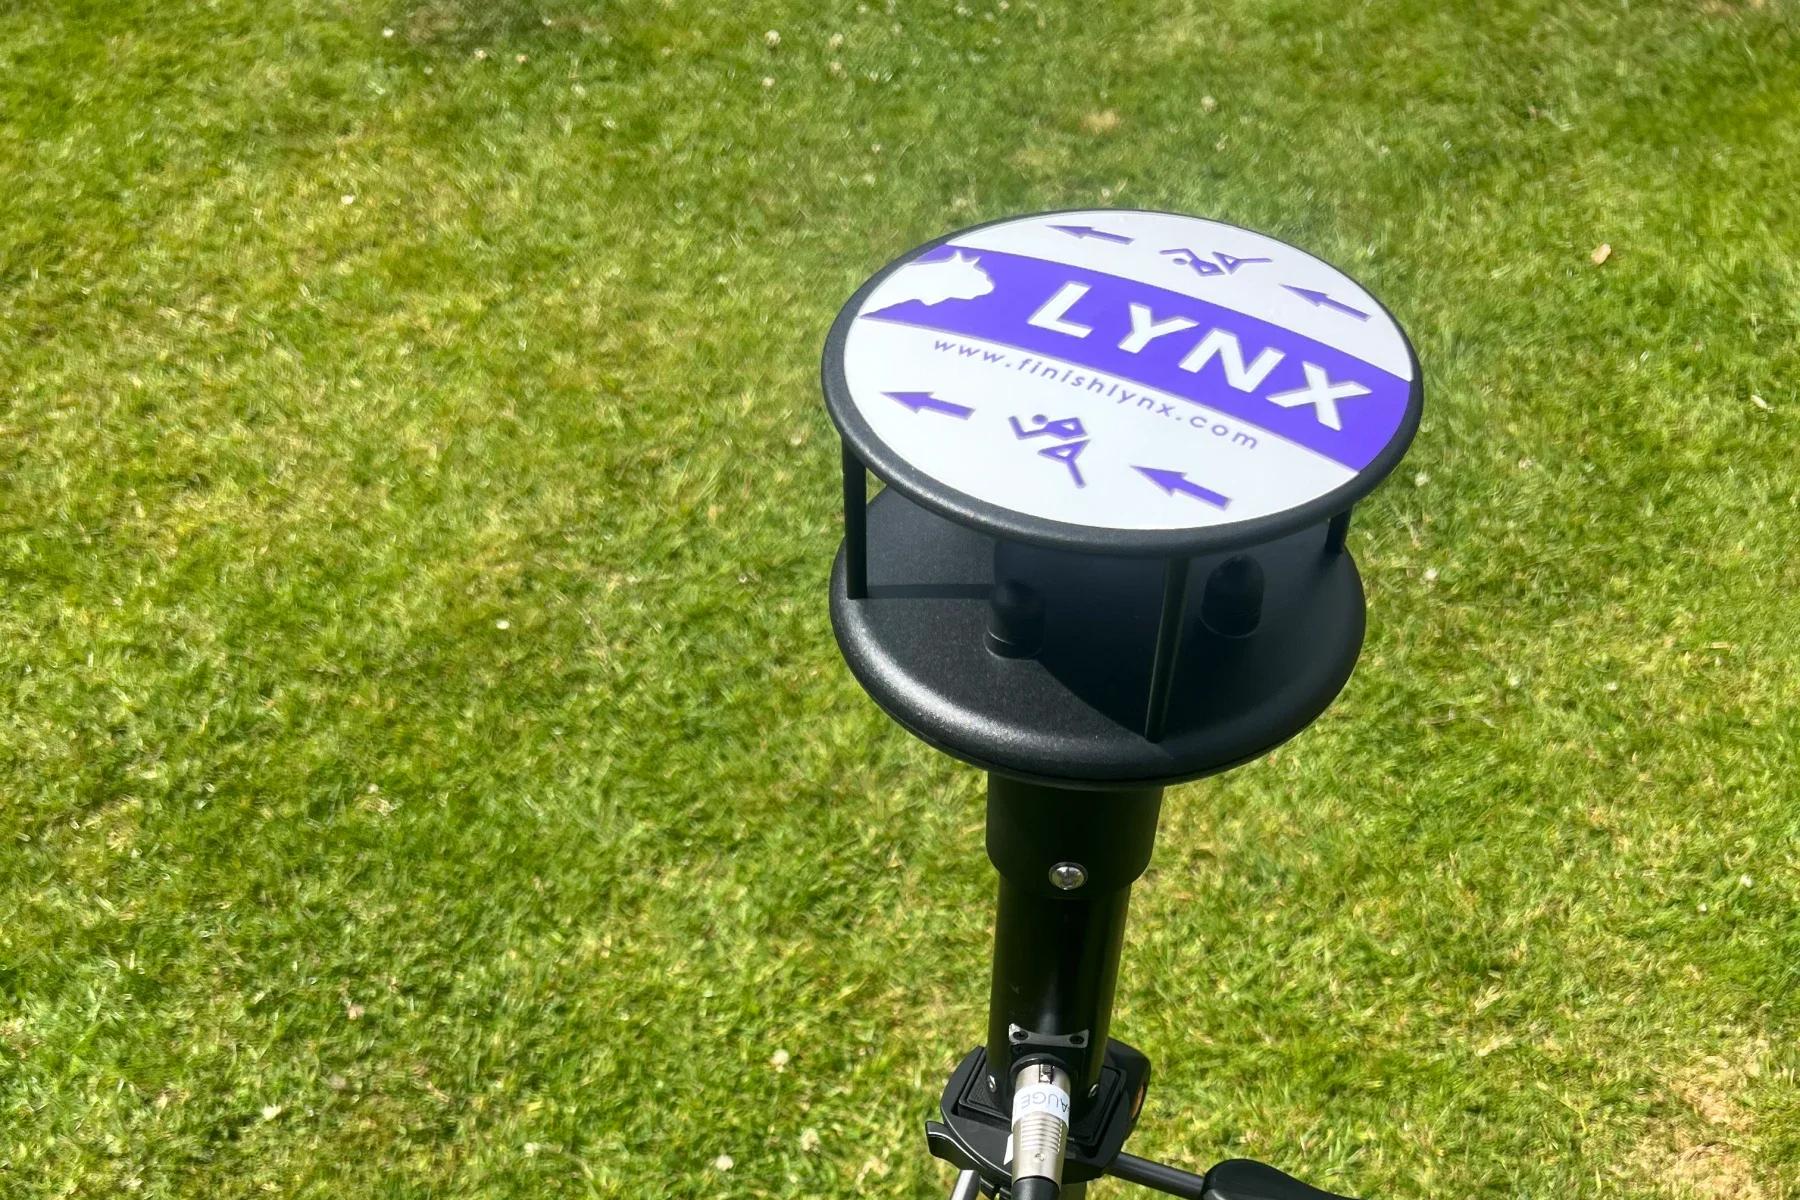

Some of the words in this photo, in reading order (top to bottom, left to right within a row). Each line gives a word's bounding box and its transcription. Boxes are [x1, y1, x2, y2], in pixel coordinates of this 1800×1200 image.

[934, 340, 1258, 450] www.finishlynx.com
[1027, 282, 1372, 431] LYNX
[1021, 1093, 1070, 1112] AUGE
